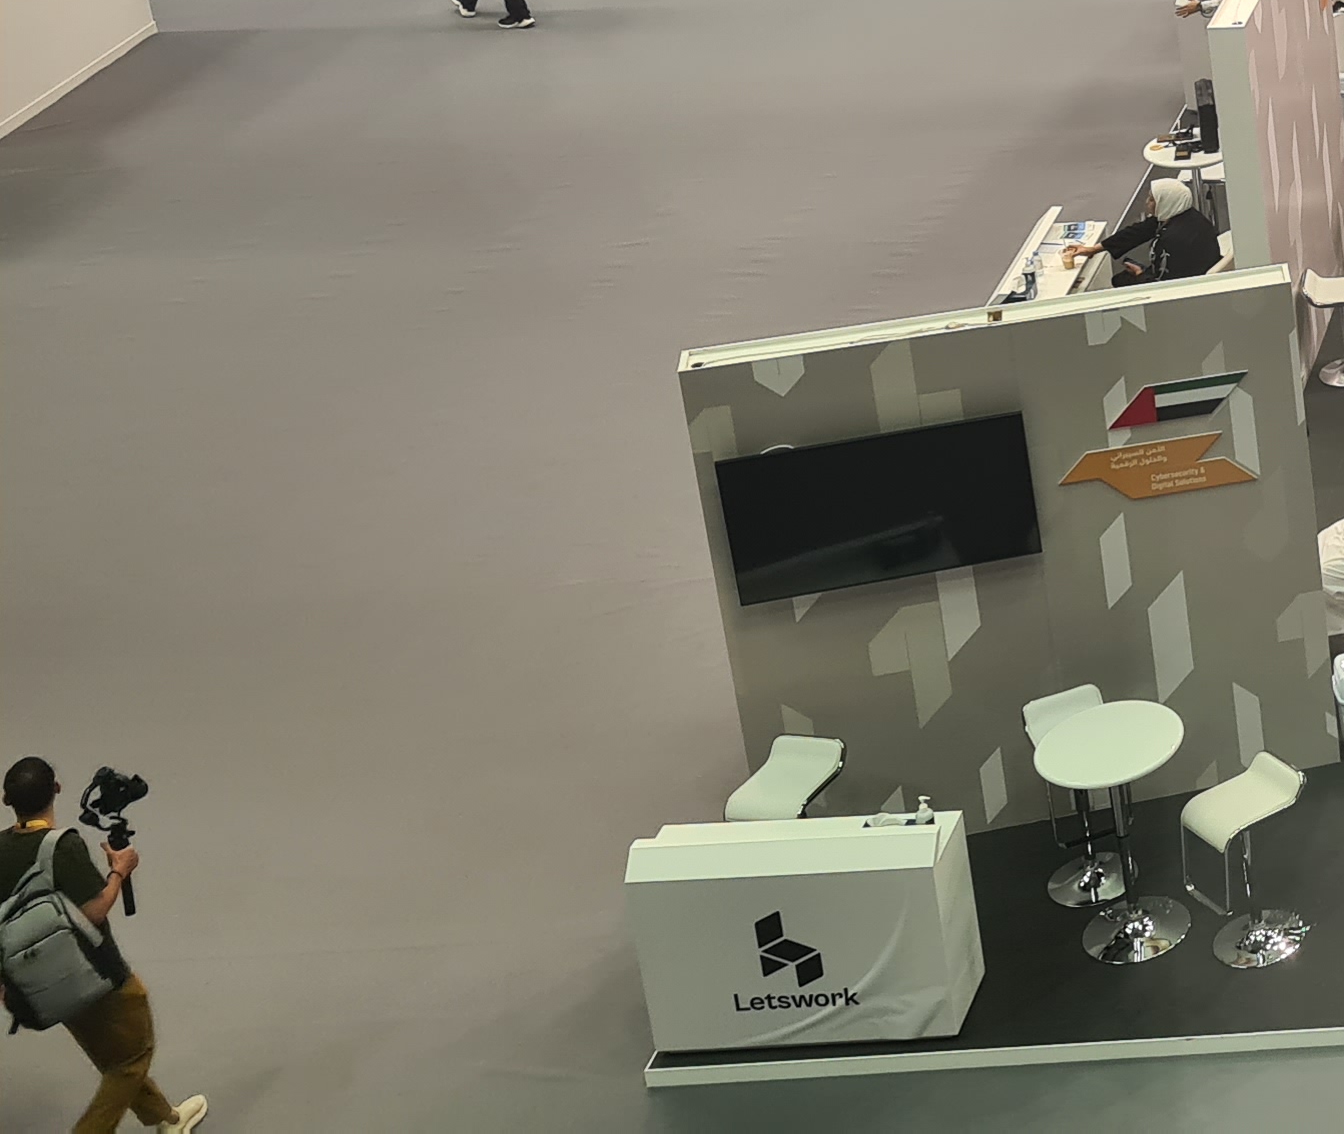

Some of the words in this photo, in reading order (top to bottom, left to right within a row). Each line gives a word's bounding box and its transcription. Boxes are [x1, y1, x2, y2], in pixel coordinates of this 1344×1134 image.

[1151, 468, 1199, 481] Cybersecurity
[1200, 466, 1205, 474] &
[1151, 480, 1174, 491] Digital
[1175, 476, 1207, 486] Solutions
[733, 987, 860, 1012] Letswork
